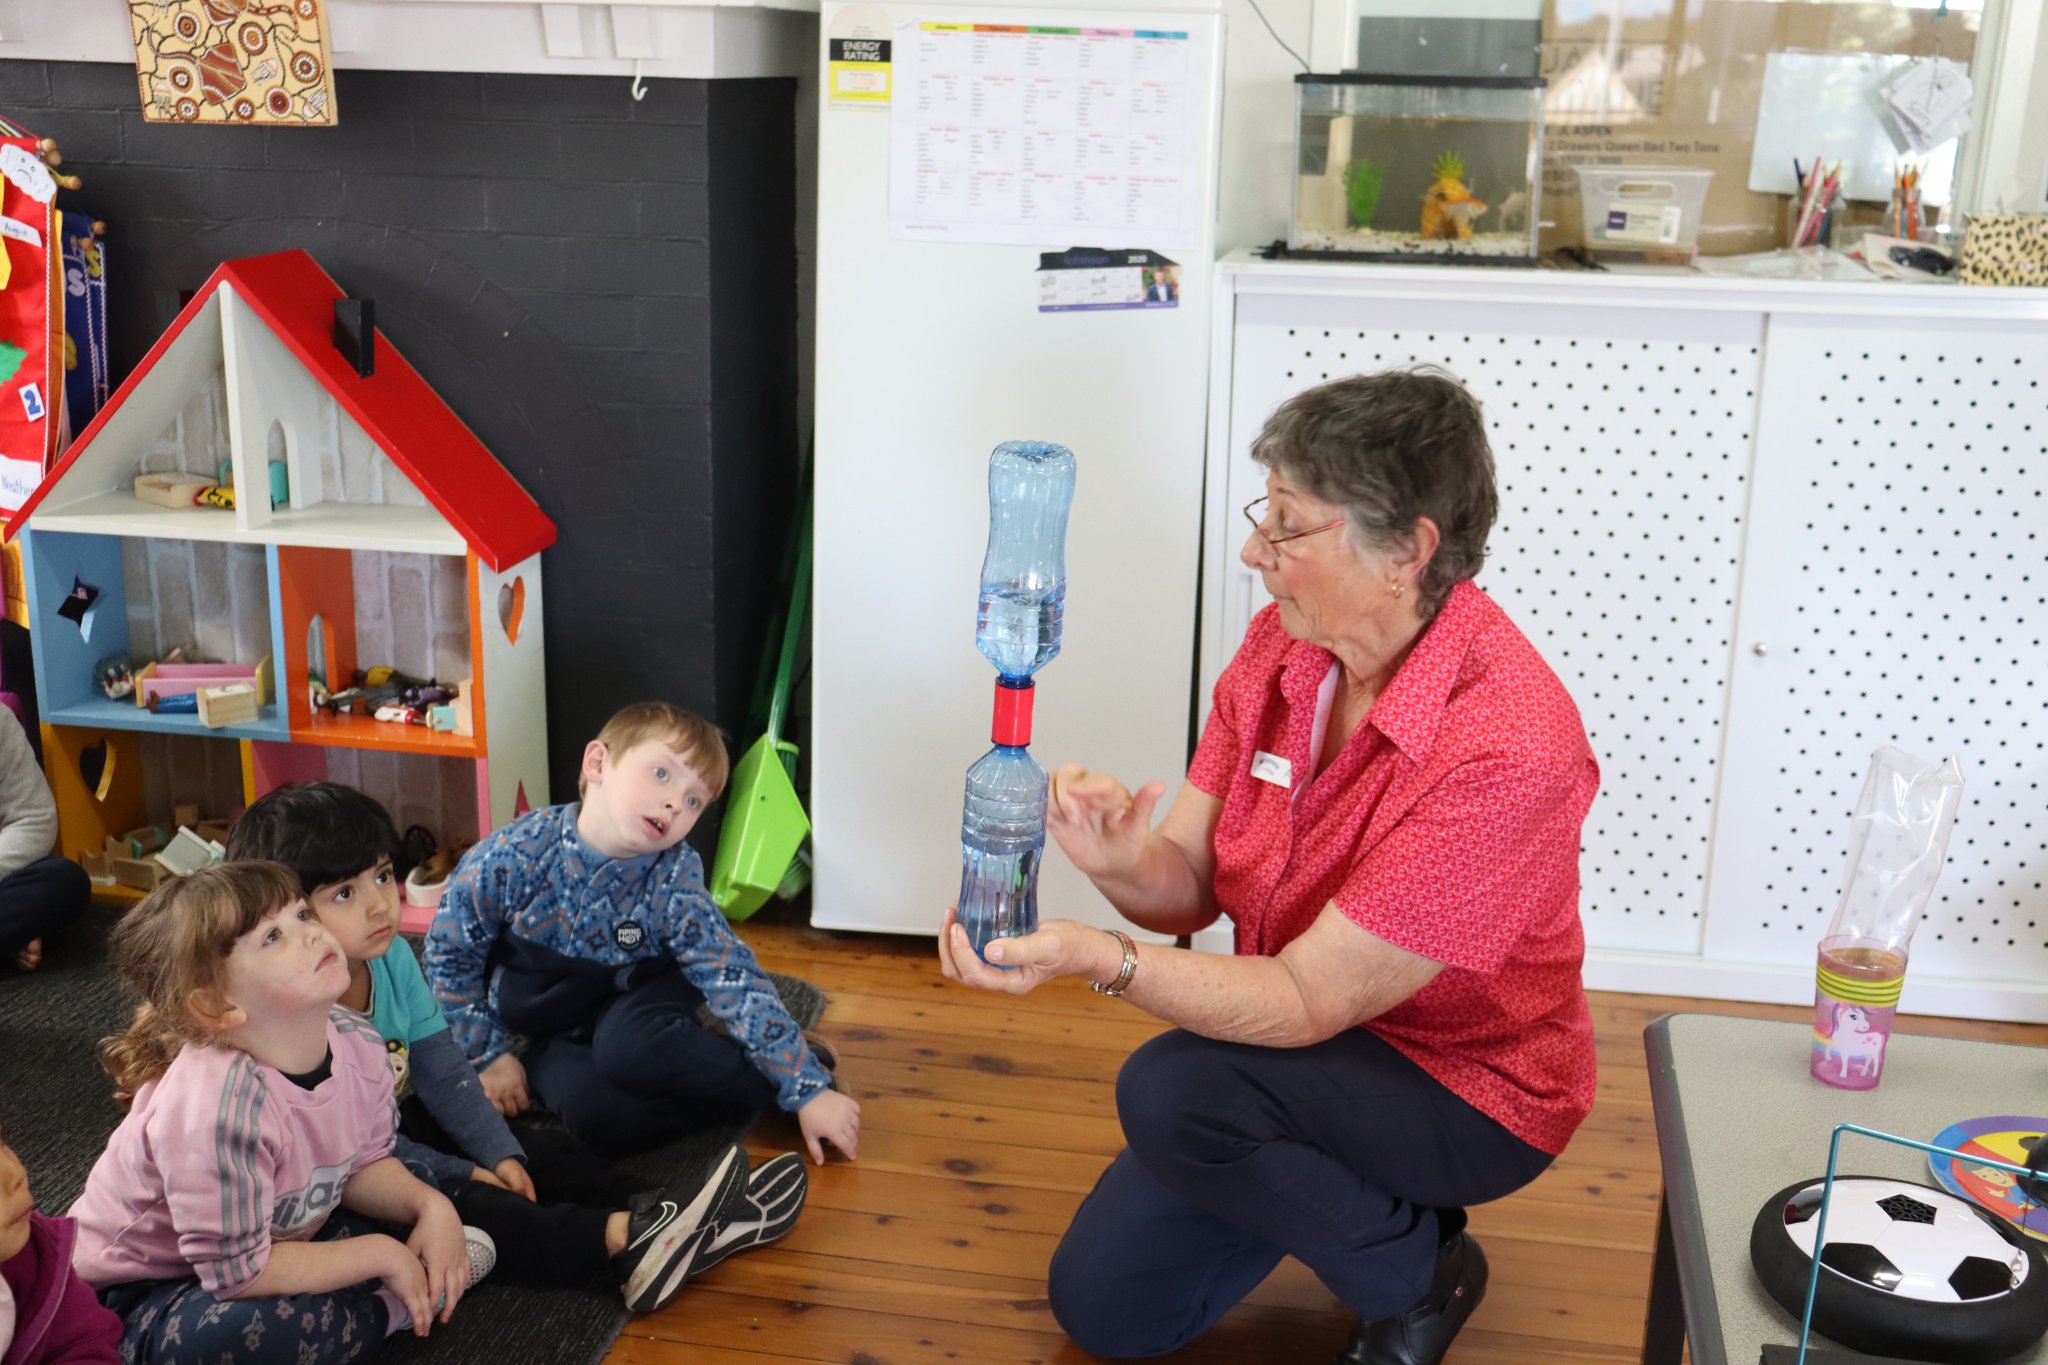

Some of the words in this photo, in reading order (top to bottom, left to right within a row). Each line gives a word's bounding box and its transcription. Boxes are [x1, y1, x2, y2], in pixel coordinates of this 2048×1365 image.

[842, 40, 881, 51] ENERGY
[843, 51, 880, 61] RATING
[1574, 126, 1612, 136] ASPEN
[1558, 141, 1600, 151] Drawers
[1605, 141, 1640, 152] Queen
[1643, 142, 1666, 152] Bed
[1669, 142, 1691, 152] Two
[1694, 141, 1720, 152] Tone
[24, 389, 41, 415] 2
[618, 928, 641, 936] PIPING
